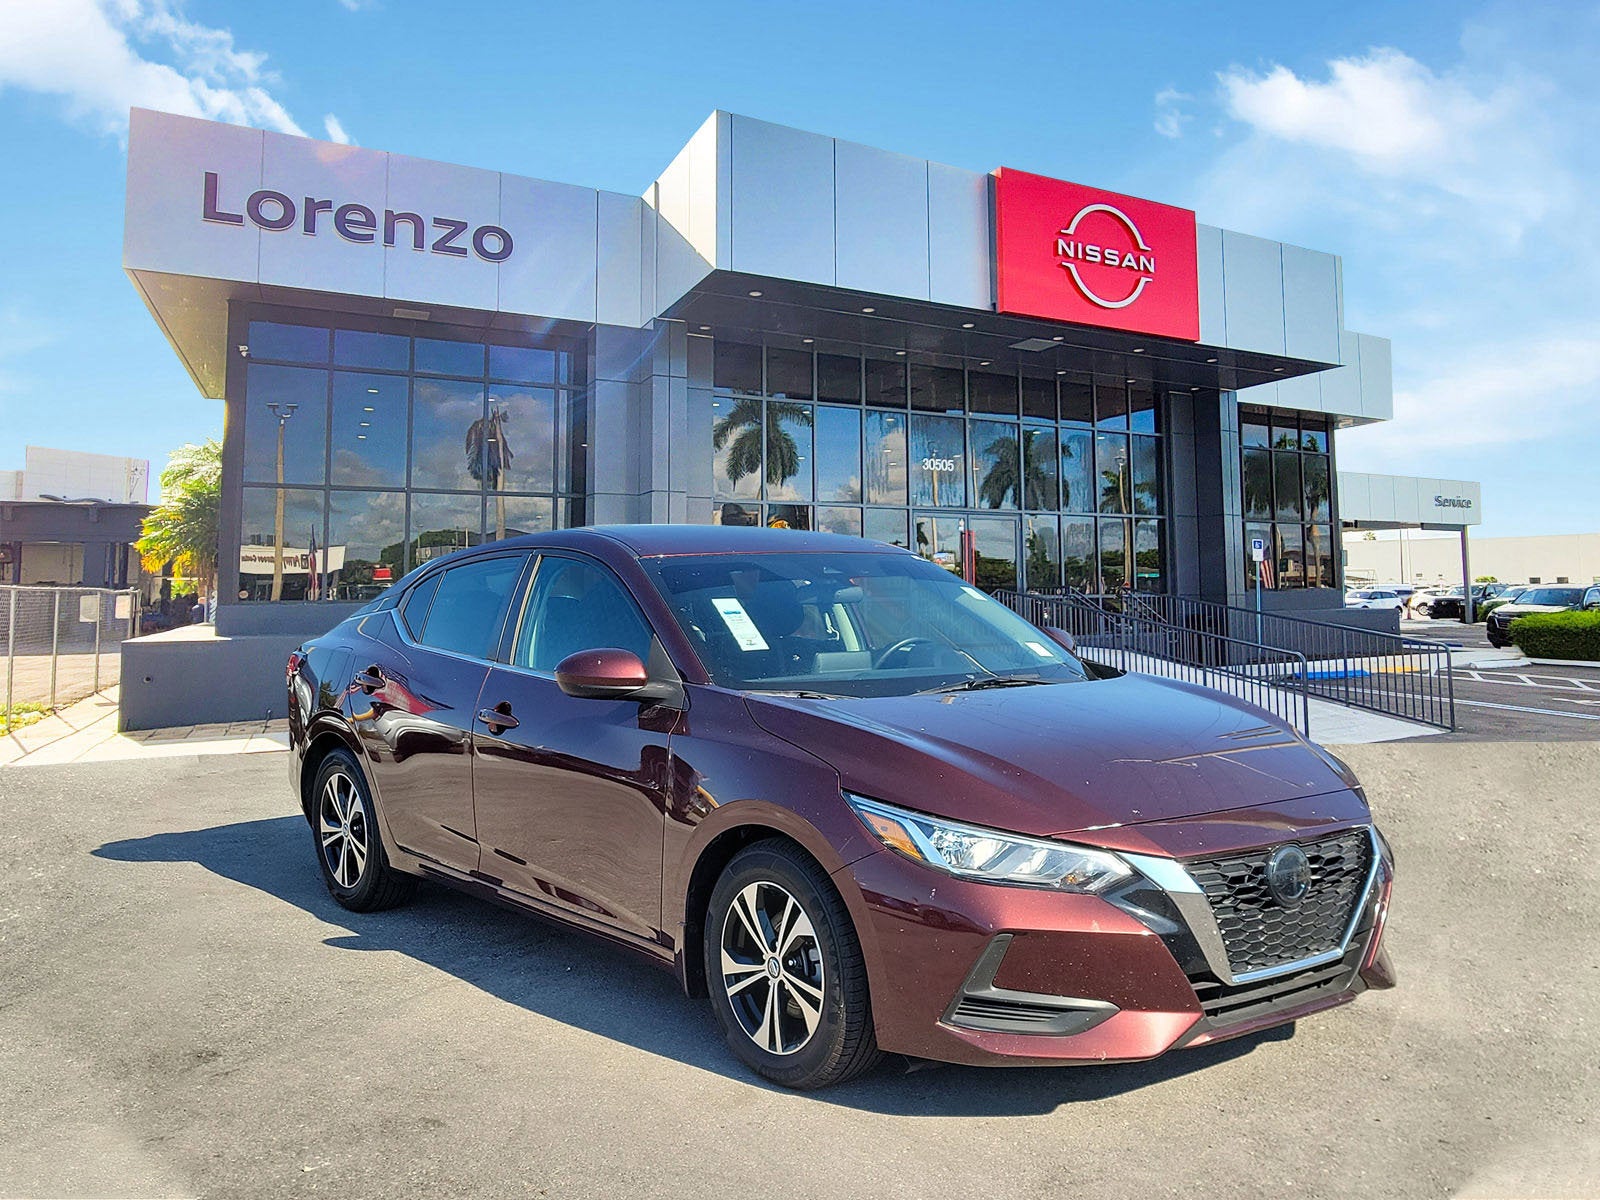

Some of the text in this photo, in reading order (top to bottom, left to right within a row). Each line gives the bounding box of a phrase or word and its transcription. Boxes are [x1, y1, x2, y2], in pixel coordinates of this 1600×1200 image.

[203, 171, 514, 262] Lorenzo
[1057, 238, 1155, 273] NISSAN
[922, 457, 955, 472] 30505
[1433, 495, 1472, 509] Service
